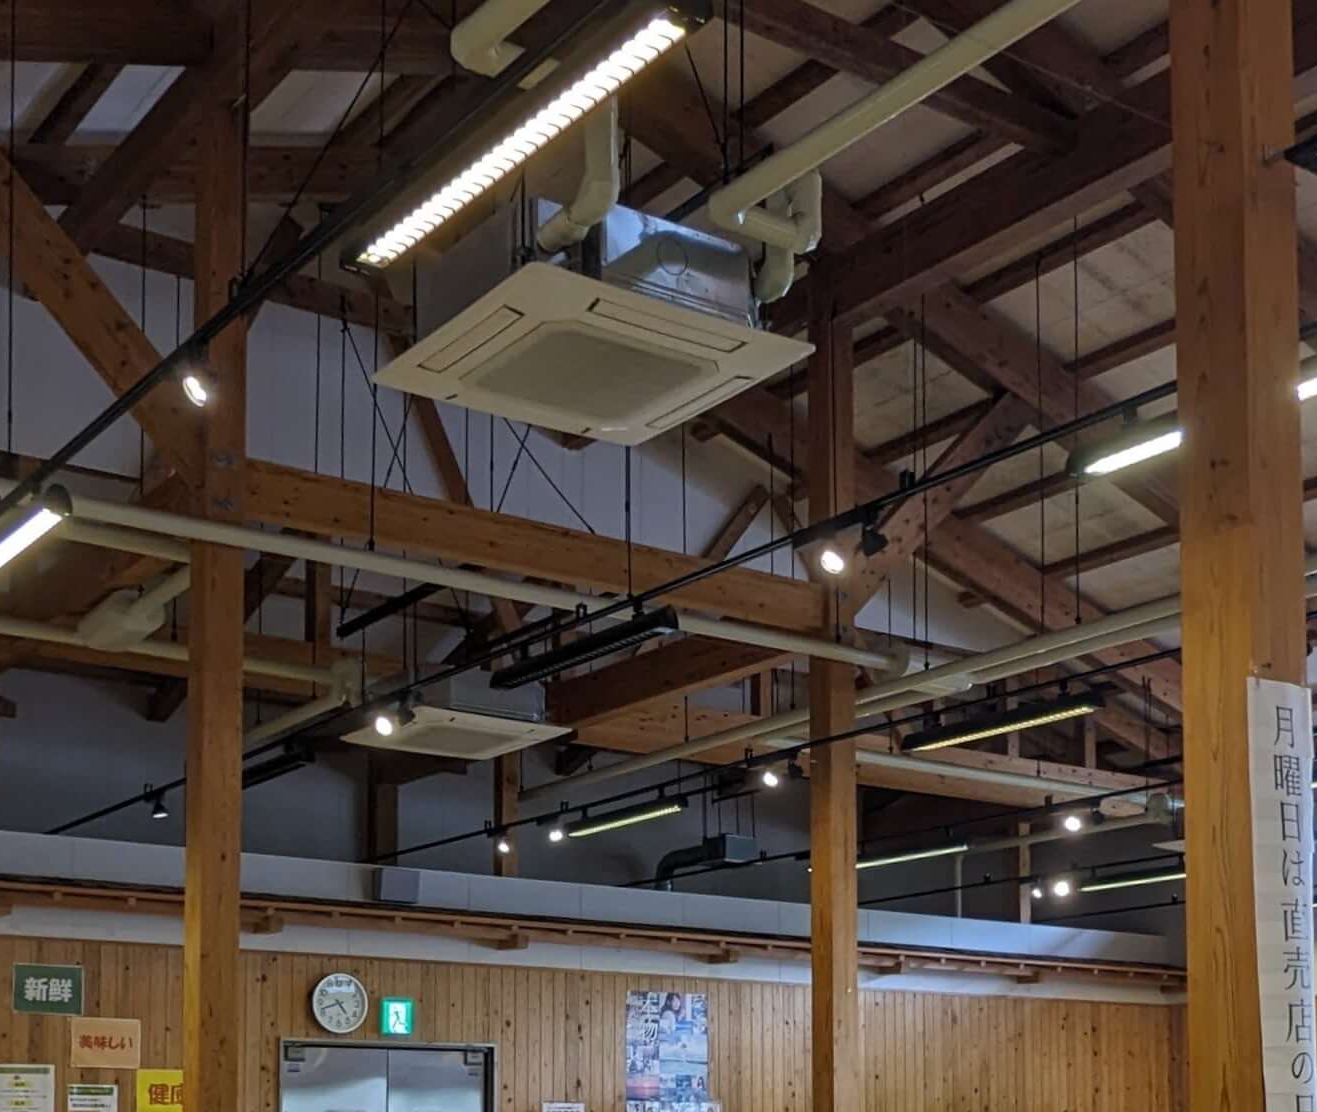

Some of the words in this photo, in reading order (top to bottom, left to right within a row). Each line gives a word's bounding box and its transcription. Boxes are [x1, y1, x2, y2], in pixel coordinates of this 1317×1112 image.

[23, 977, 73, 1003] 新鮮
[79, 1034, 133, 1050] 美味しい
